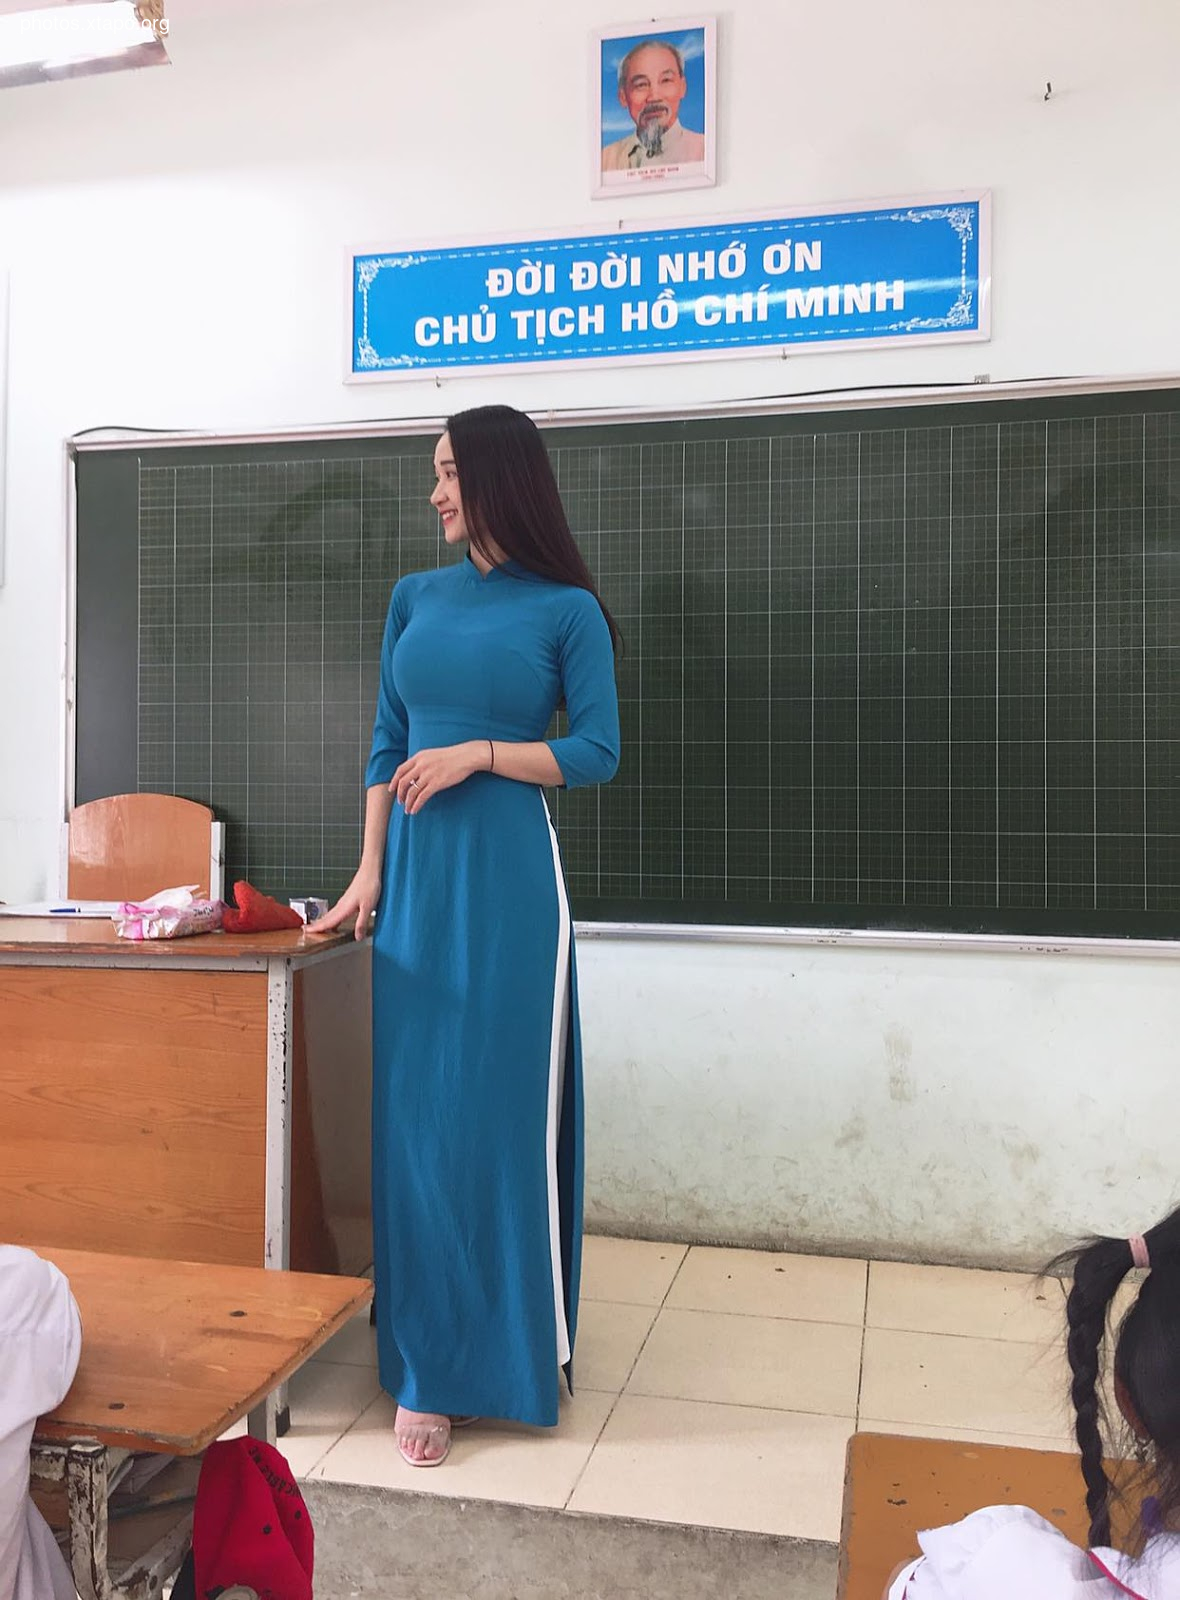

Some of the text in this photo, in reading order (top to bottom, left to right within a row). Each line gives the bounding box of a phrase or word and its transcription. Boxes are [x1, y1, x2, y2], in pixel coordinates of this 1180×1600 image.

[485, 239, 822, 298] ĐỜI ĐỜI NHỚ ƠN
[414, 279, 905, 348] CHỦ TỊCH HỒ CHÍ MINH
